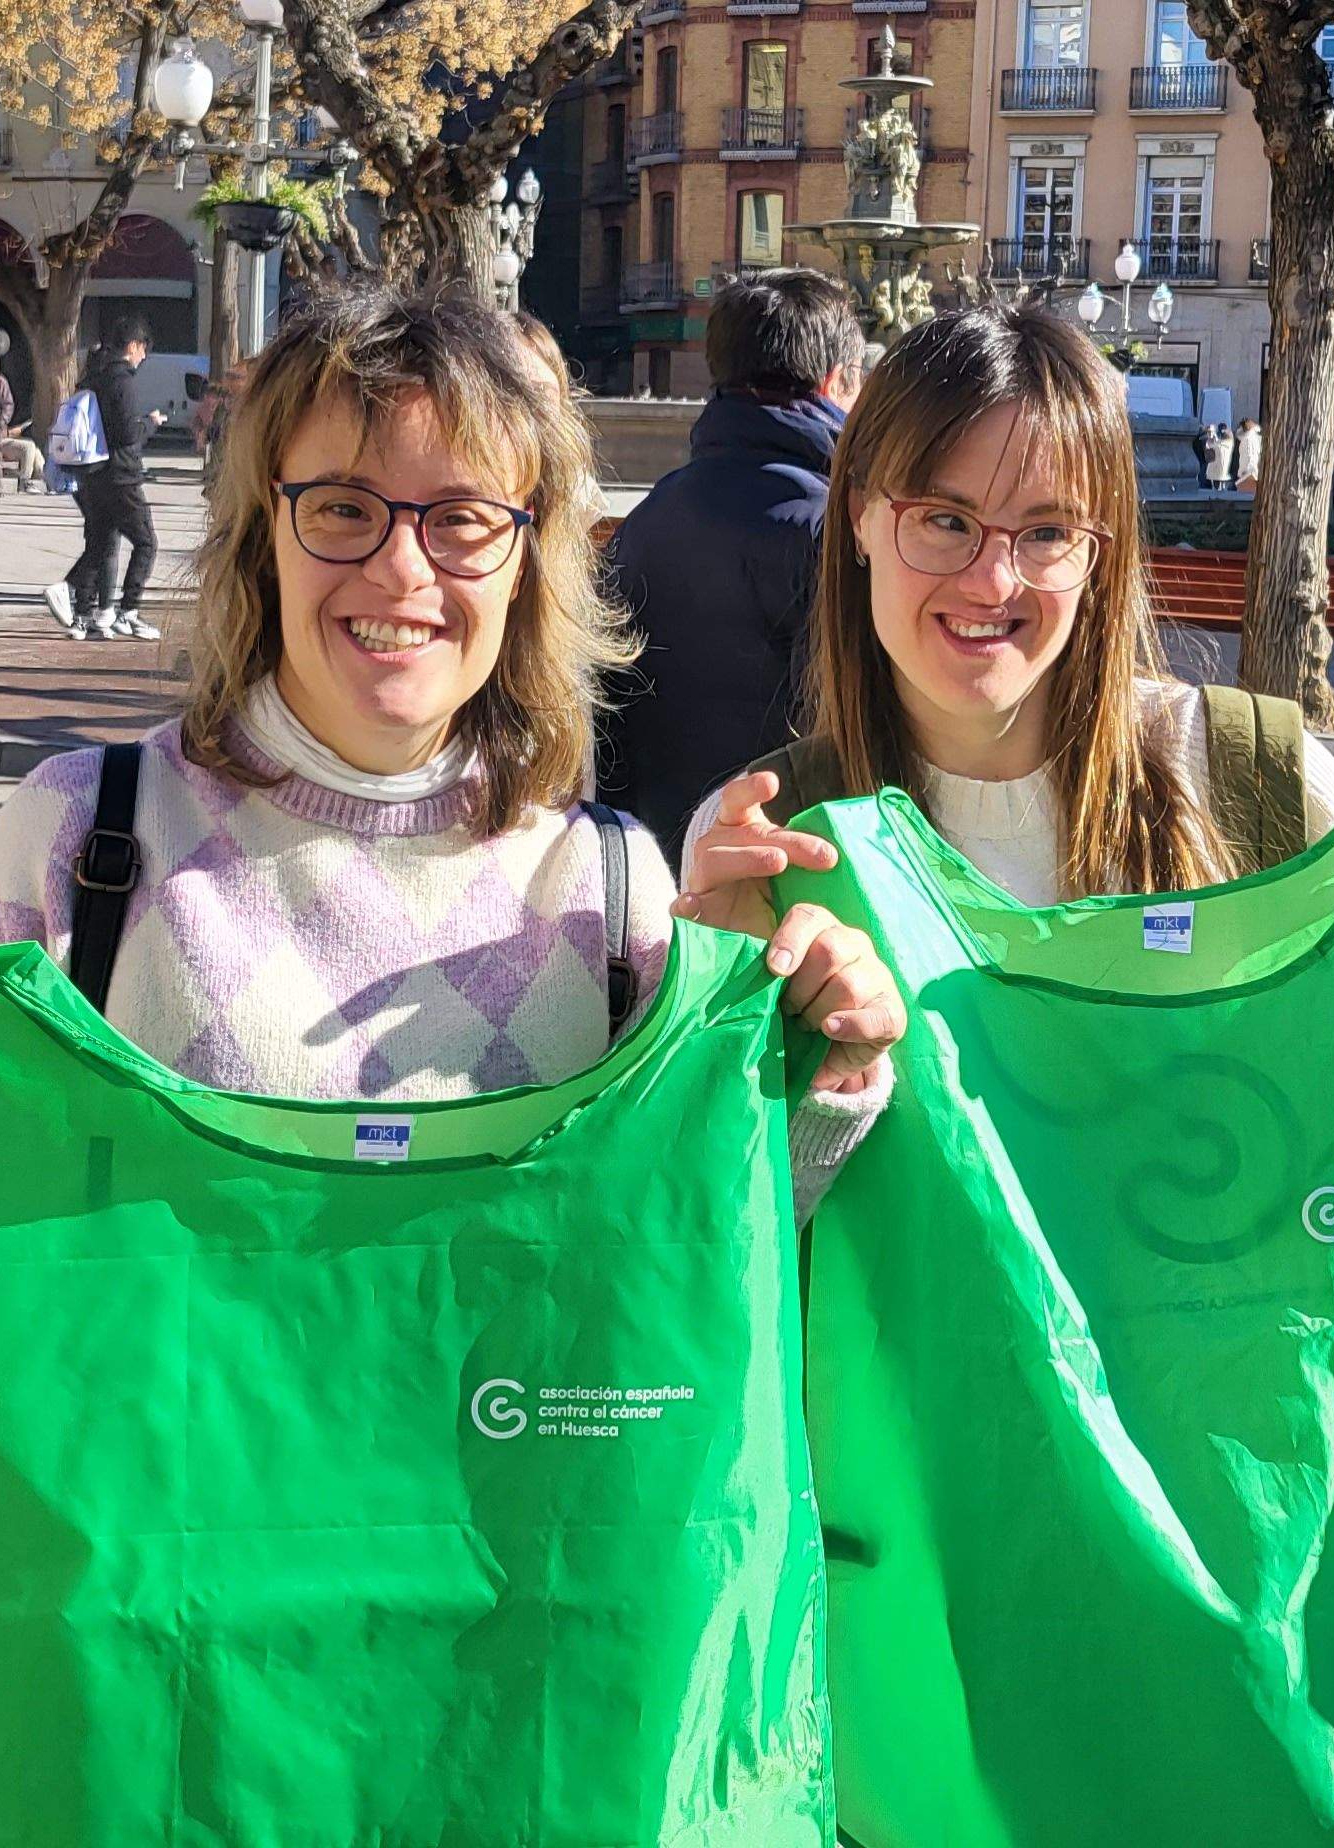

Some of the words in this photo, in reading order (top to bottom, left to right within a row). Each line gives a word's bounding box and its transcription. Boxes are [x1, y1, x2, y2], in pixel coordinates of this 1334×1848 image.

[1154, 916, 1179, 930] mkt
[369, 1125, 397, 1141] mkt
[539, 1386, 622, 1400] asociación
[625, 1385, 695, 1404] española
[538, 1405, 588, 1418] contra
[592, 1404, 606, 1418] el
[610, 1404, 664, 1419] cáncer
[538, 1423, 556, 1436] en
[561, 1422, 619, 1437] Huesca
